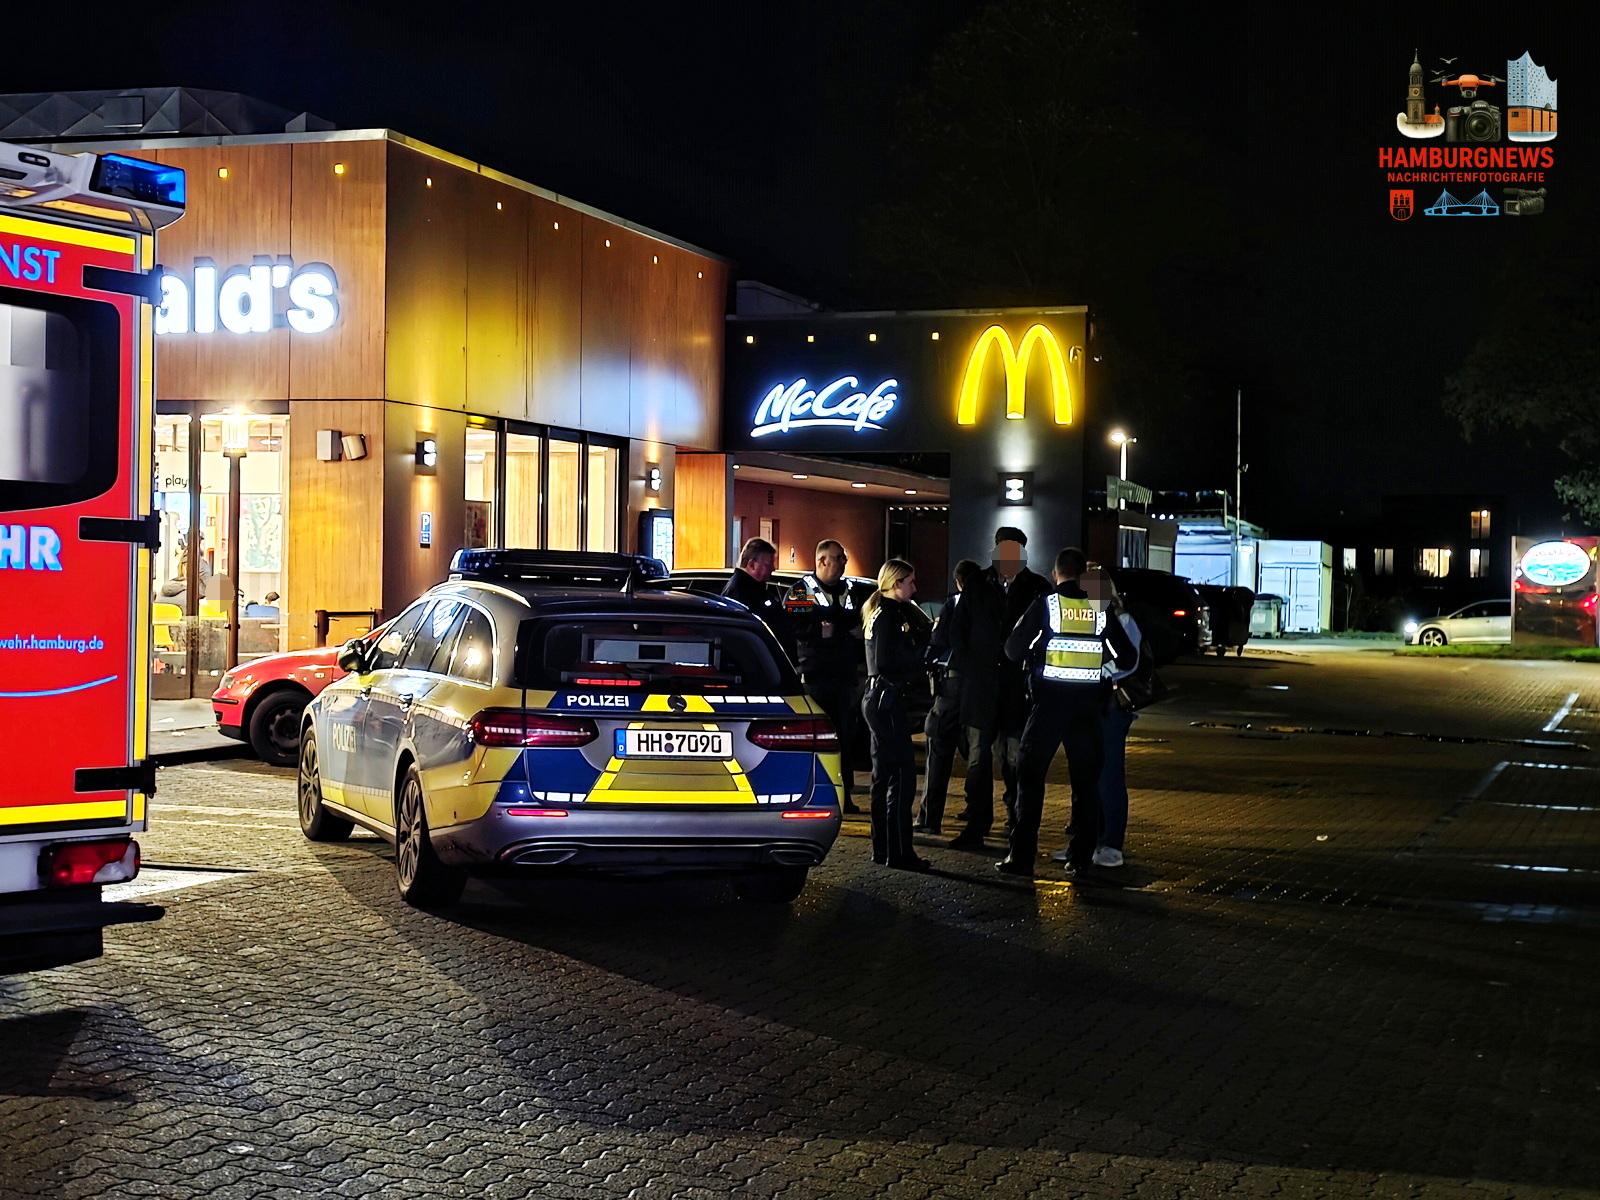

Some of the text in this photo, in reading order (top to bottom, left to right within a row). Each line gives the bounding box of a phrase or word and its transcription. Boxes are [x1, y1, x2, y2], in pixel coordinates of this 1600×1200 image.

[751, 376, 898, 435] McCafé
[1062, 608, 1095, 622] POLIZEI
[566, 695, 629, 707] POLIZEI
[332, 723, 357, 754] POLIZEI
[637, 733, 662, 752] HH
[676, 734, 722, 753] 7090
